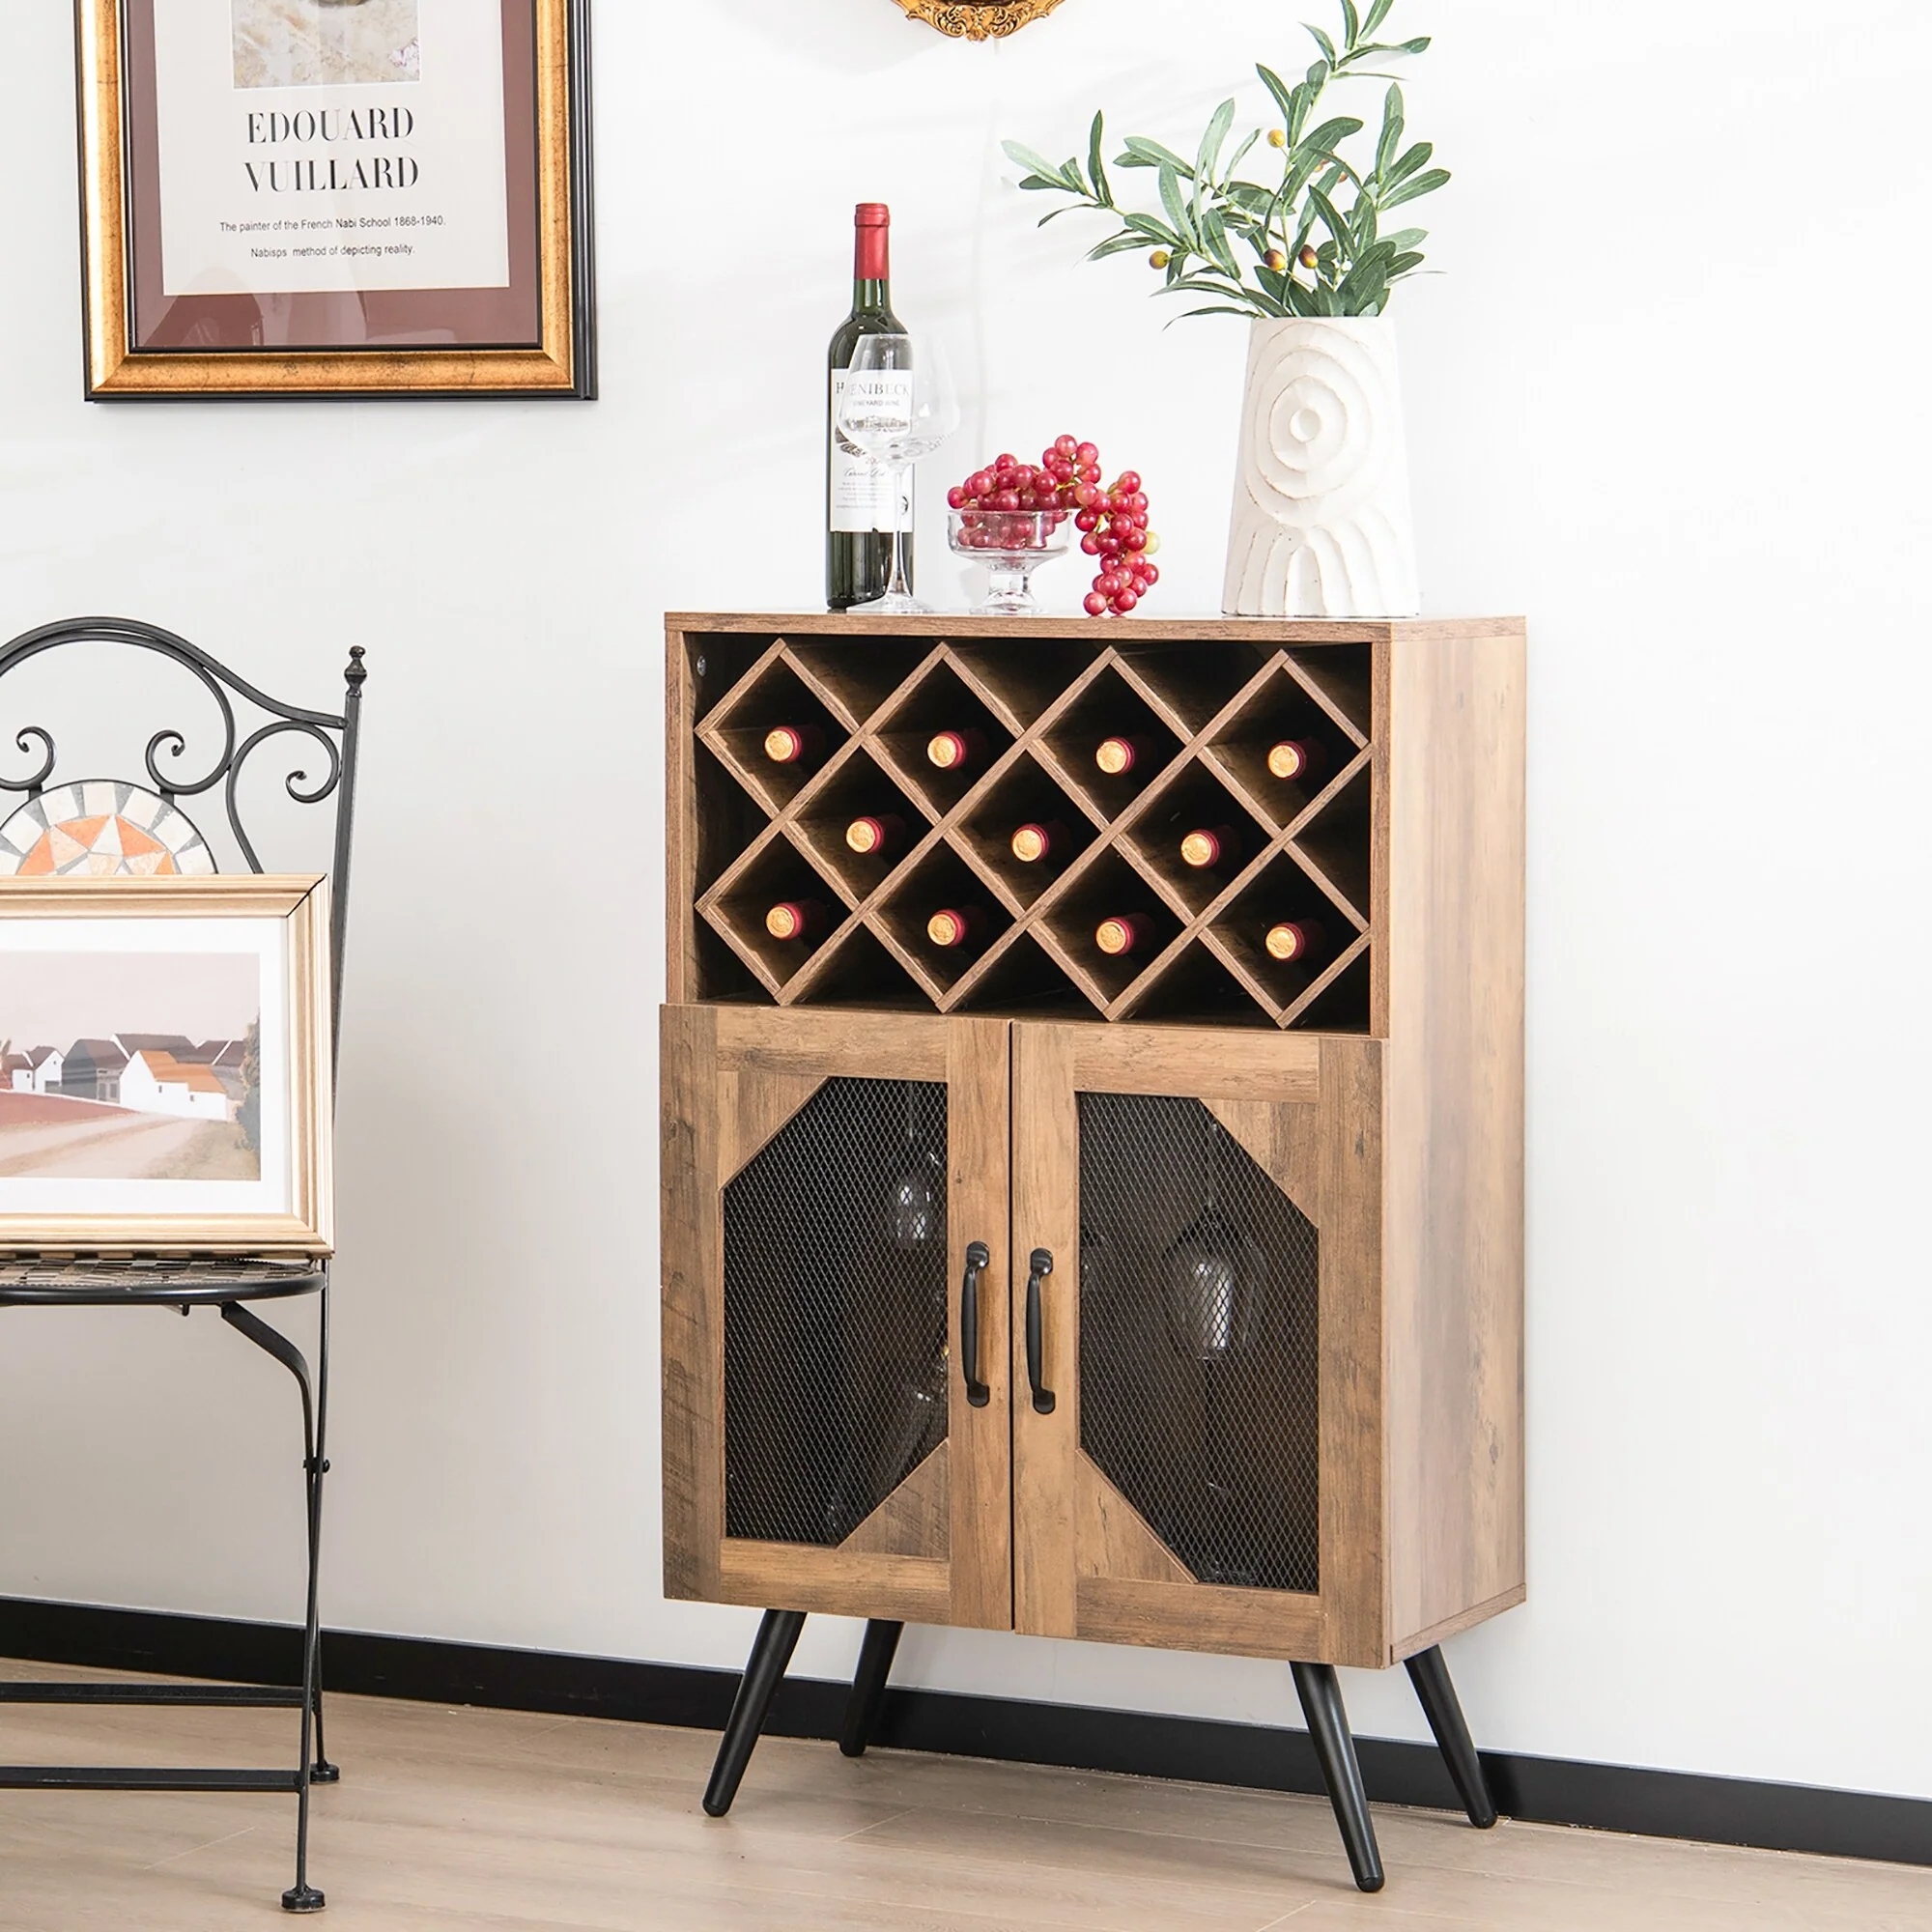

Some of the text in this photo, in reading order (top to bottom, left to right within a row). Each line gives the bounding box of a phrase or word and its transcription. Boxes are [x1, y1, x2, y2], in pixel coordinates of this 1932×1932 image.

[247, 107, 414, 144] EDOUARD
[243, 156, 419, 193] VUILLARD
[220, 214, 446, 234] The painter of the French Nabi School 1868-1940.
[250, 242, 415, 260] Nabisps method of depicting reality.
